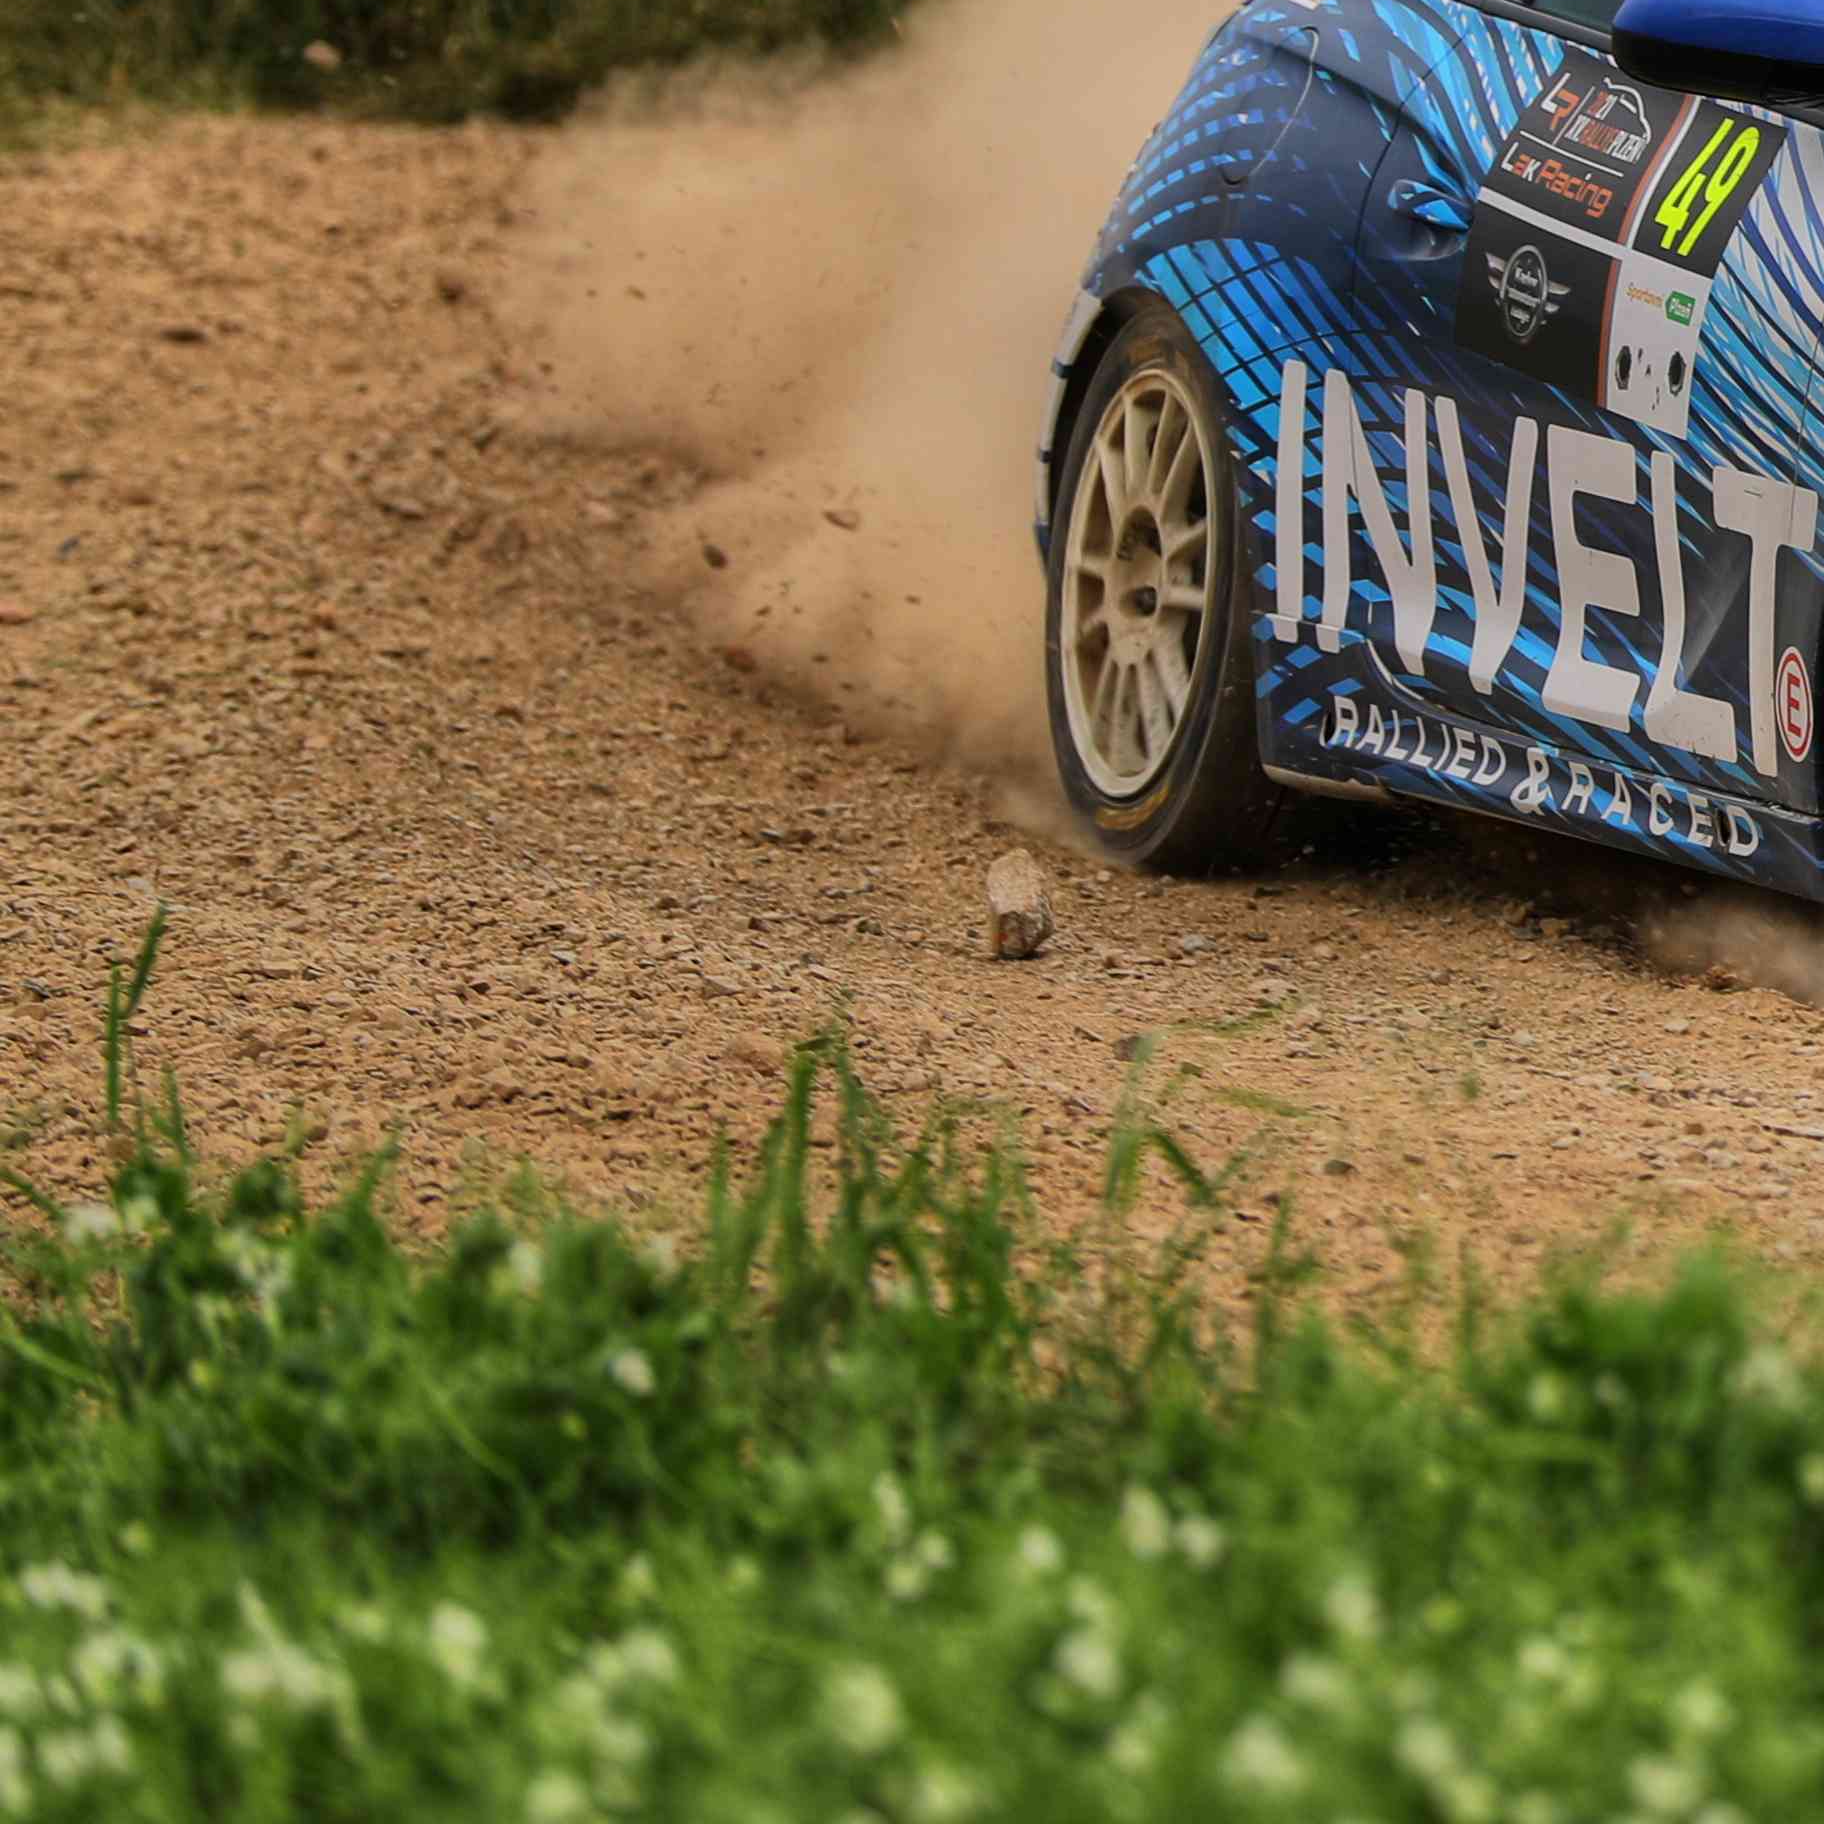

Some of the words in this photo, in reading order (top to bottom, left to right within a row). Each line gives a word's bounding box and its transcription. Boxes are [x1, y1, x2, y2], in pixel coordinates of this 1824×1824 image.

[1536, 159, 1613, 219] Racing
[1655, 118, 1760, 257] 49
[1273, 359, 1819, 778] INVELT
[1323, 695, 1508, 787] RALLIED
[1509, 748, 1553, 816] &
[1562, 762, 1761, 858] RACED
